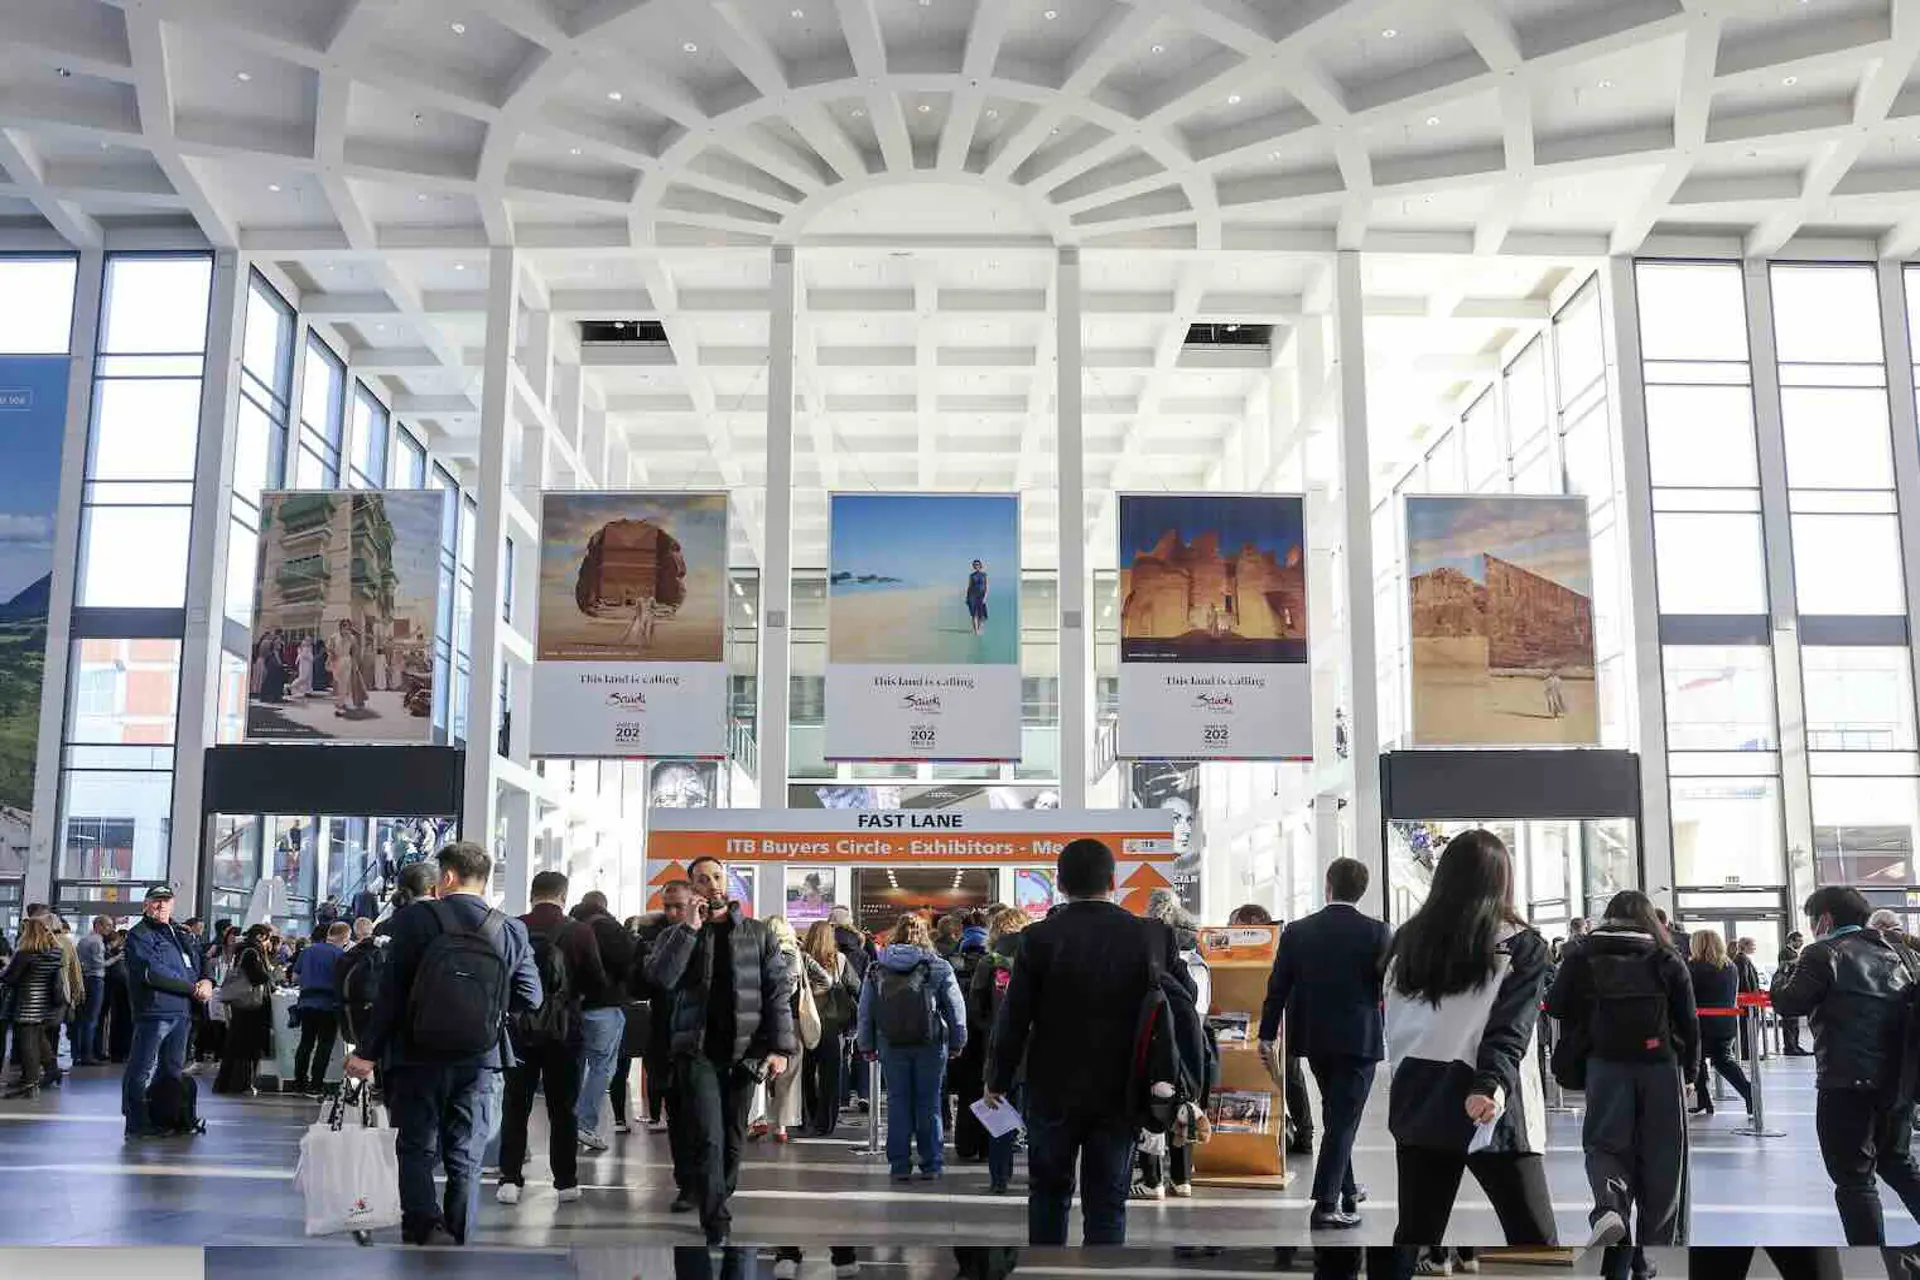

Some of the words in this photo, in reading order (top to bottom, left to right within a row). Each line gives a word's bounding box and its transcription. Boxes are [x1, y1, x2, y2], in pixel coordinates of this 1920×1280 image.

[580, 673, 602, 684] This
[604, 673, 628, 684] land
[631, 673, 640, 684] is
[642, 673, 680, 686] calling
[873, 675, 896, 686] This
[898, 675, 923, 686] land
[925, 675, 935, 686] is
[936, 675, 975, 689] calling
[1167, 675, 1188, 687] This
[1191, 675, 1215, 686] land
[1217, 675, 1226, 686] is
[1229, 675, 1265, 688] calling
[858, 814, 905, 828] FAST
[911, 814, 963, 828] LANE
[726, 839, 757, 853] ITB
[762, 839, 829, 857] Buyers
[836, 839, 891, 854] Circle
[908, 839, 1014, 855] Exhibitors
